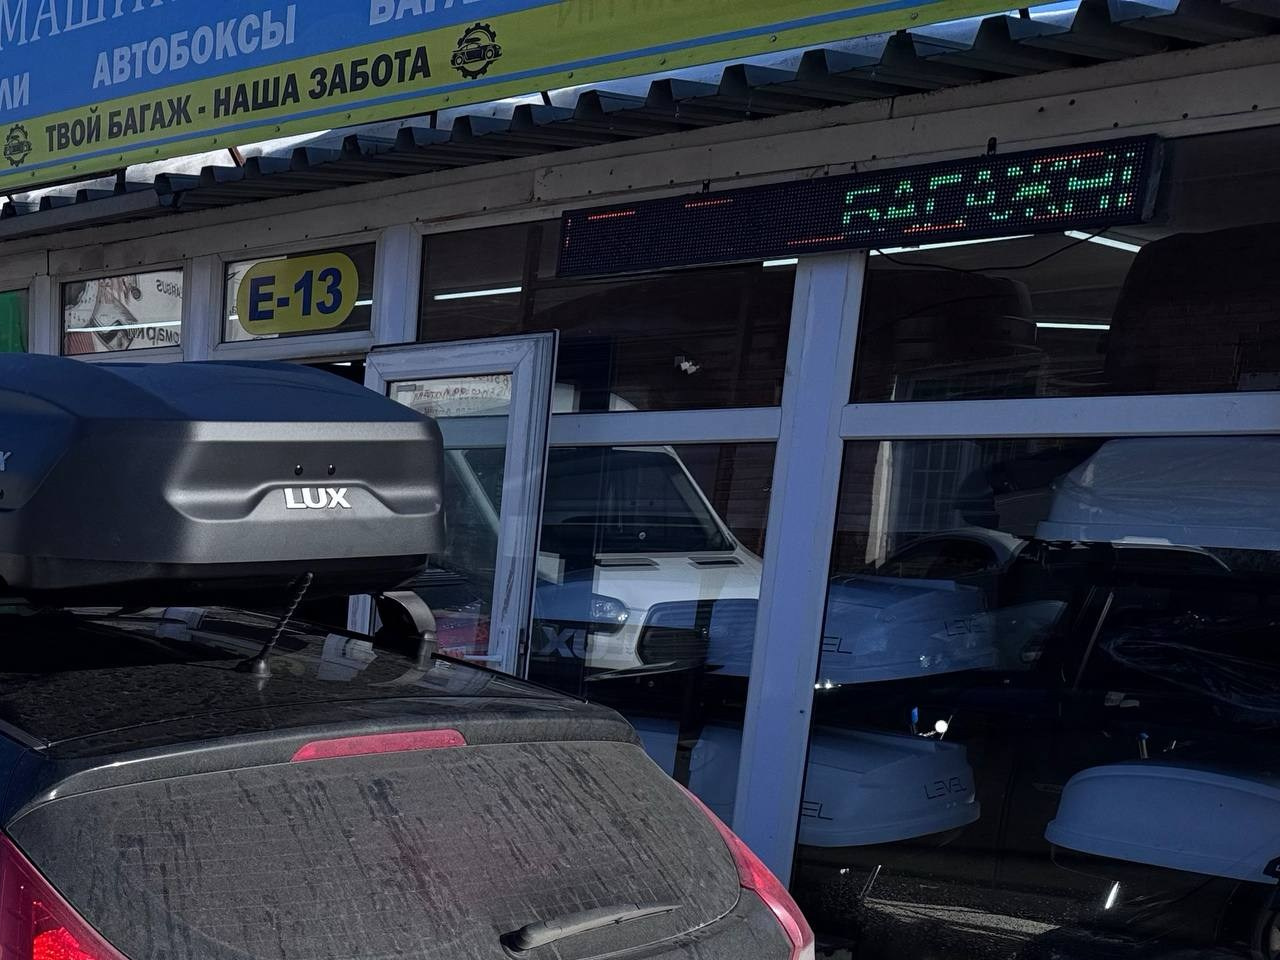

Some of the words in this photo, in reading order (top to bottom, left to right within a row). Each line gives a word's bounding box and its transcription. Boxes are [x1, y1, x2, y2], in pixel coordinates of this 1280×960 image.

[92, 4, 296, 89] АВТОБОКСЫ
[45, 106, 101, 152] ТВОЙ
[108, 94, 193, 140] БАГАЖ
[213, 73, 301, 119] НАША
[308, 45, 432, 100] ЗАБОТА
[283, 487, 352, 510] LUX
[923, 777, 968, 800] LEVEL
